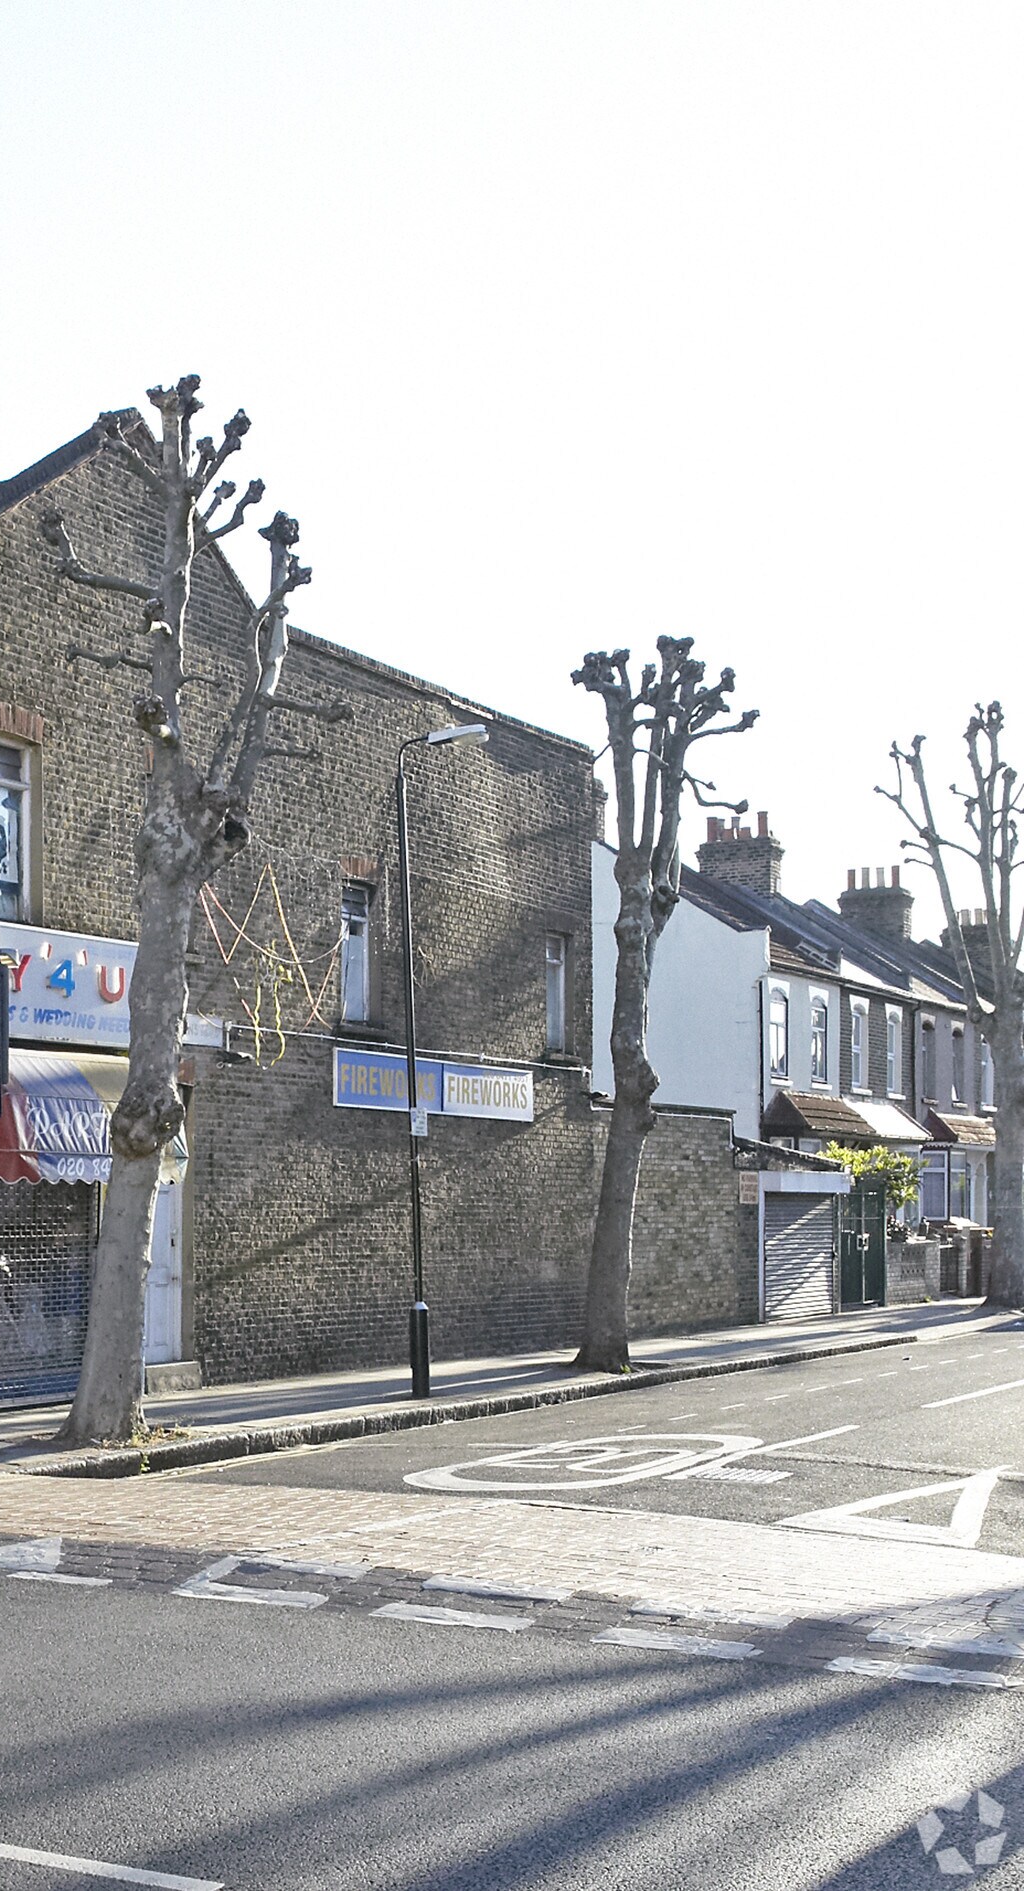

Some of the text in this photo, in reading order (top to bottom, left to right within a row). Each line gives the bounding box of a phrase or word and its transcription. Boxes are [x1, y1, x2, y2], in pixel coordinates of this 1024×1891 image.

[96, 964, 126, 1003] U
[19, 1006, 29, 1023] &
[33, 1008, 96, 1030] WEDDING
[340, 1062, 528, 1110] FIREWOKS FIREWORKS
[57, 1157, 111, 1177] 020 84
